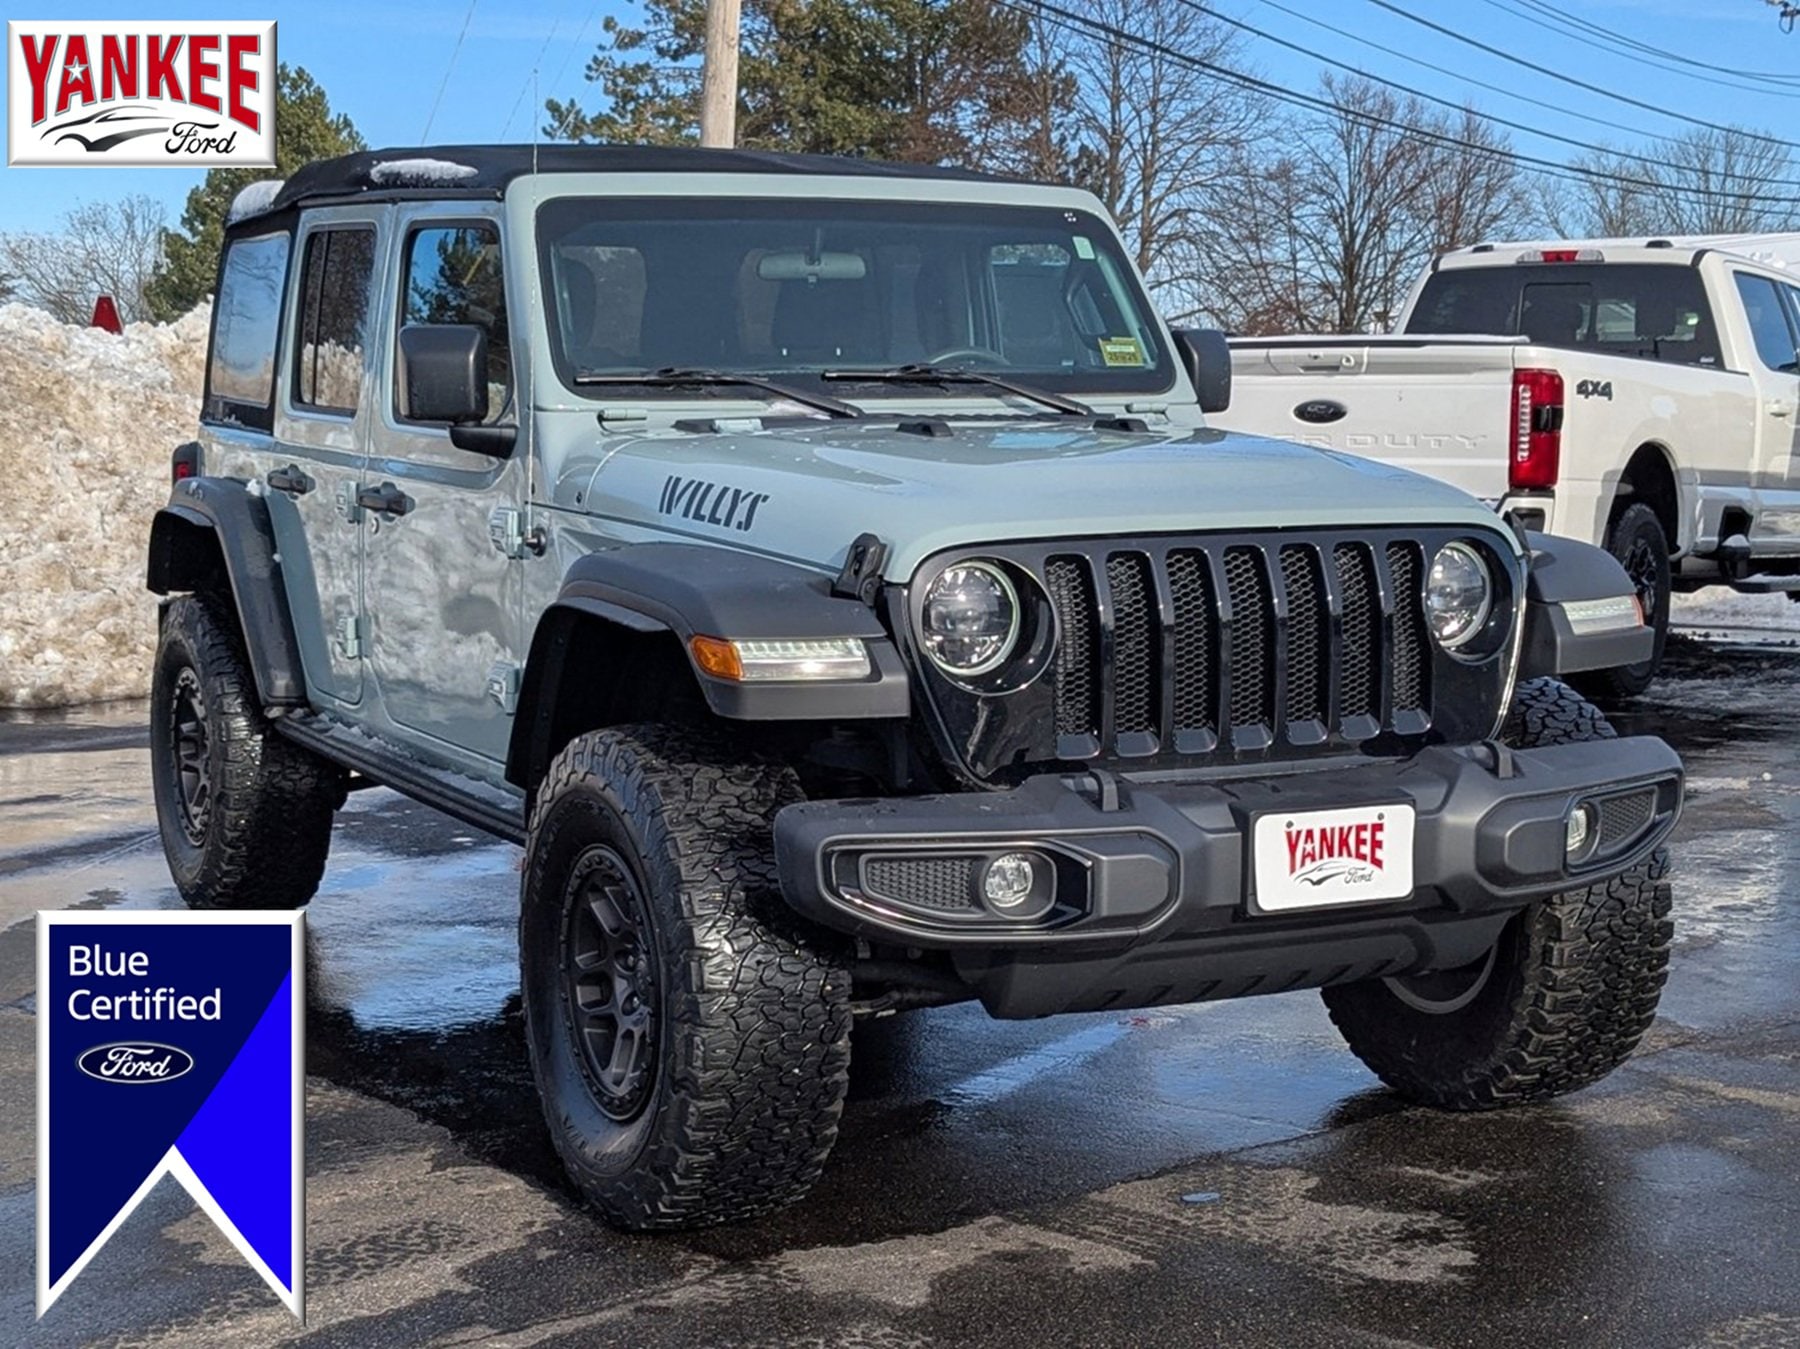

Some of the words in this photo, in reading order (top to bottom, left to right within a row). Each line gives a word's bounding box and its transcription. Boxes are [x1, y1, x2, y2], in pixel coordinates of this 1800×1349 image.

[1346, 432, 1488, 449] DUTY
[658, 475, 770, 532] WILLYS
[1285, 822, 1385, 877] YANKEE
[1344, 866, 1374, 884] Ford
